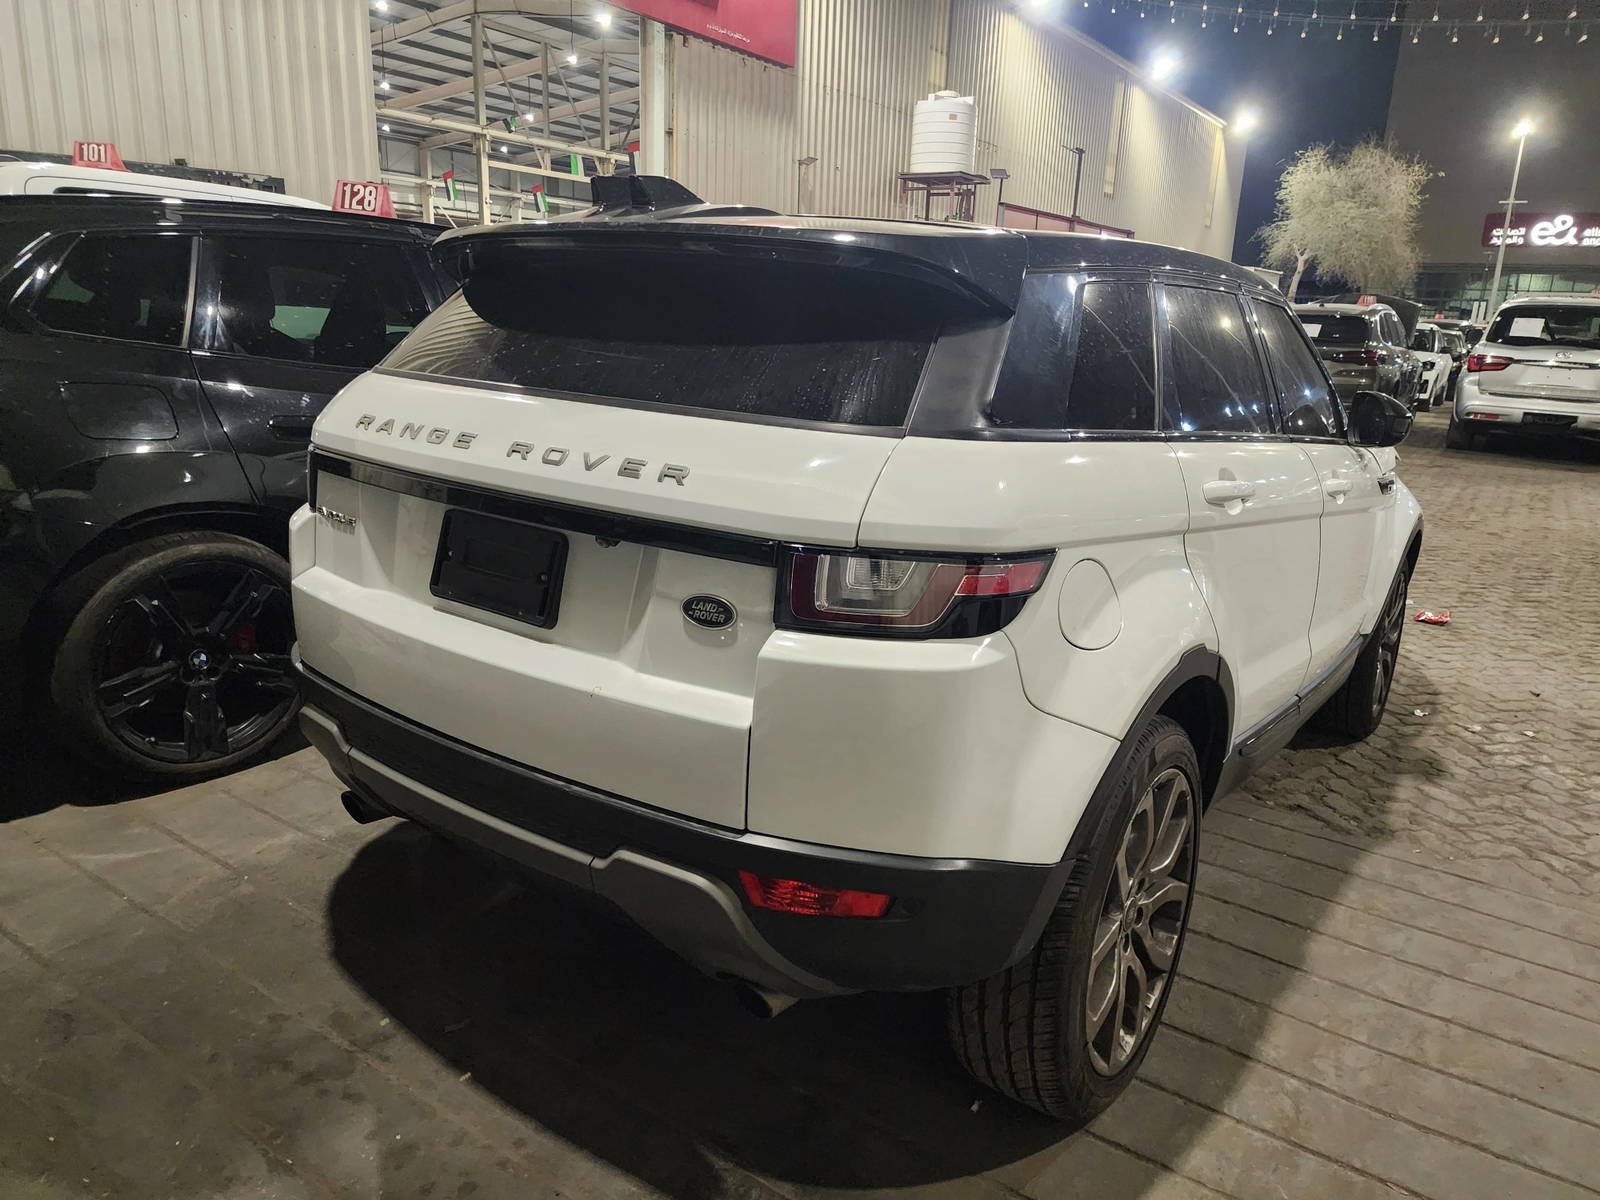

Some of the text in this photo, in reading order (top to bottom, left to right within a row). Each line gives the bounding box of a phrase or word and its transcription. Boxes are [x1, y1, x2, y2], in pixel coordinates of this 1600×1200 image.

[81, 143, 106, 163] 101
[343, 183, 377, 212] 128
[355, 413, 691, 487] RANGE ROVER
